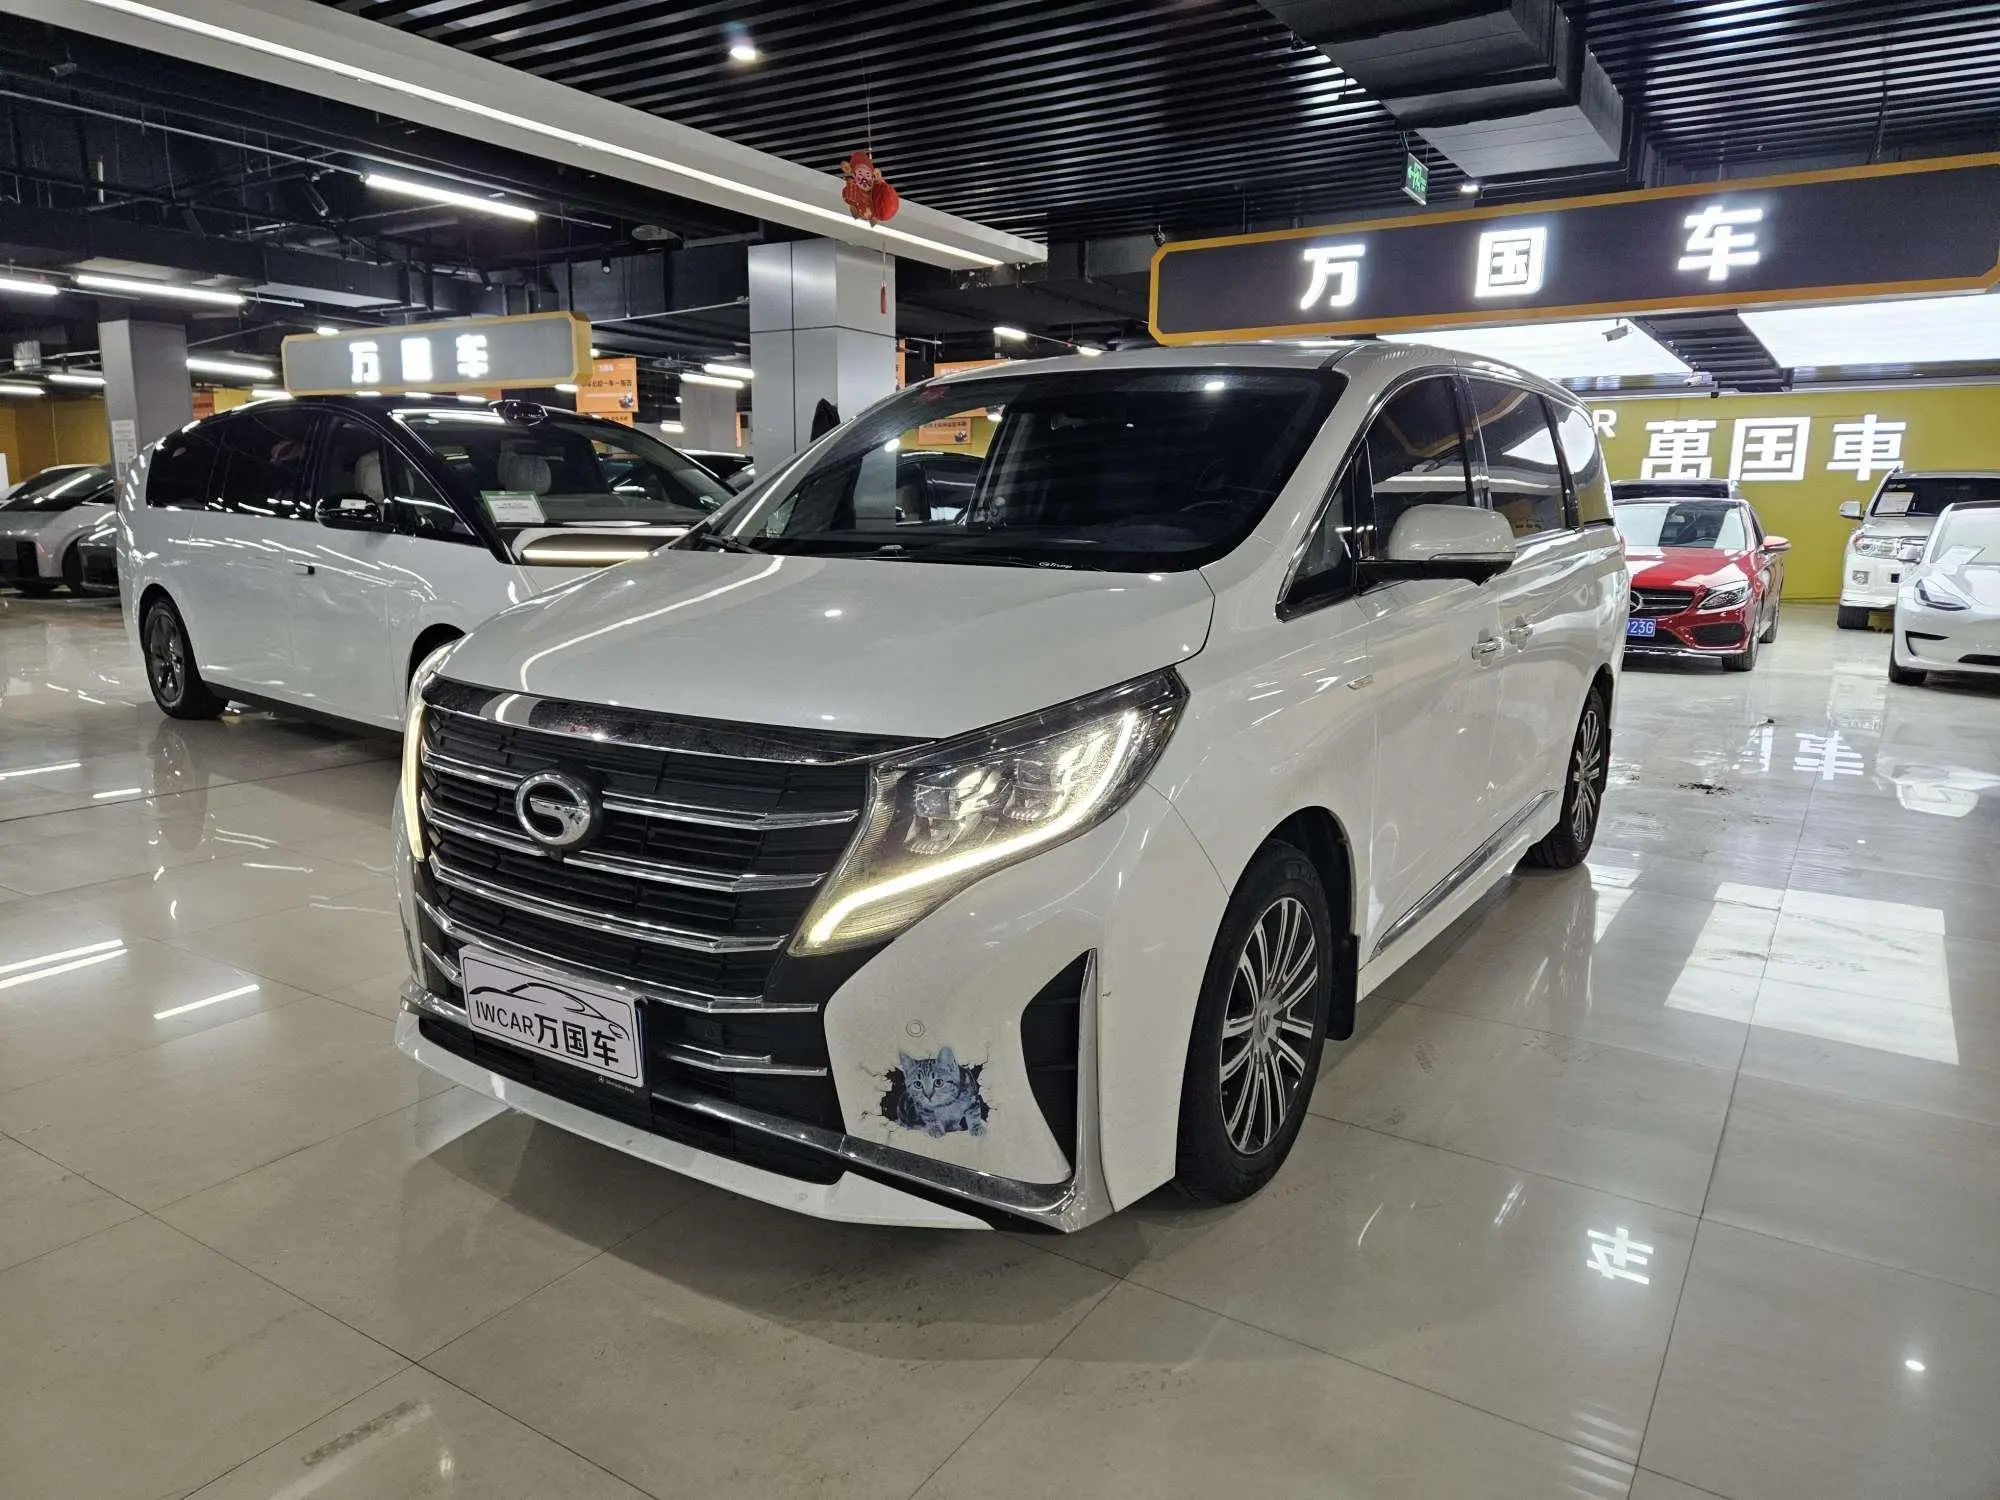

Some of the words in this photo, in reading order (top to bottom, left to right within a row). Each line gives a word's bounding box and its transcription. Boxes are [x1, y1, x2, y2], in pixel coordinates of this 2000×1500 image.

[1300, 205, 1764, 310] 万国车
[349, 334, 489, 383] 万车
[475, 1000, 619, 1067] IWCAR万国车
